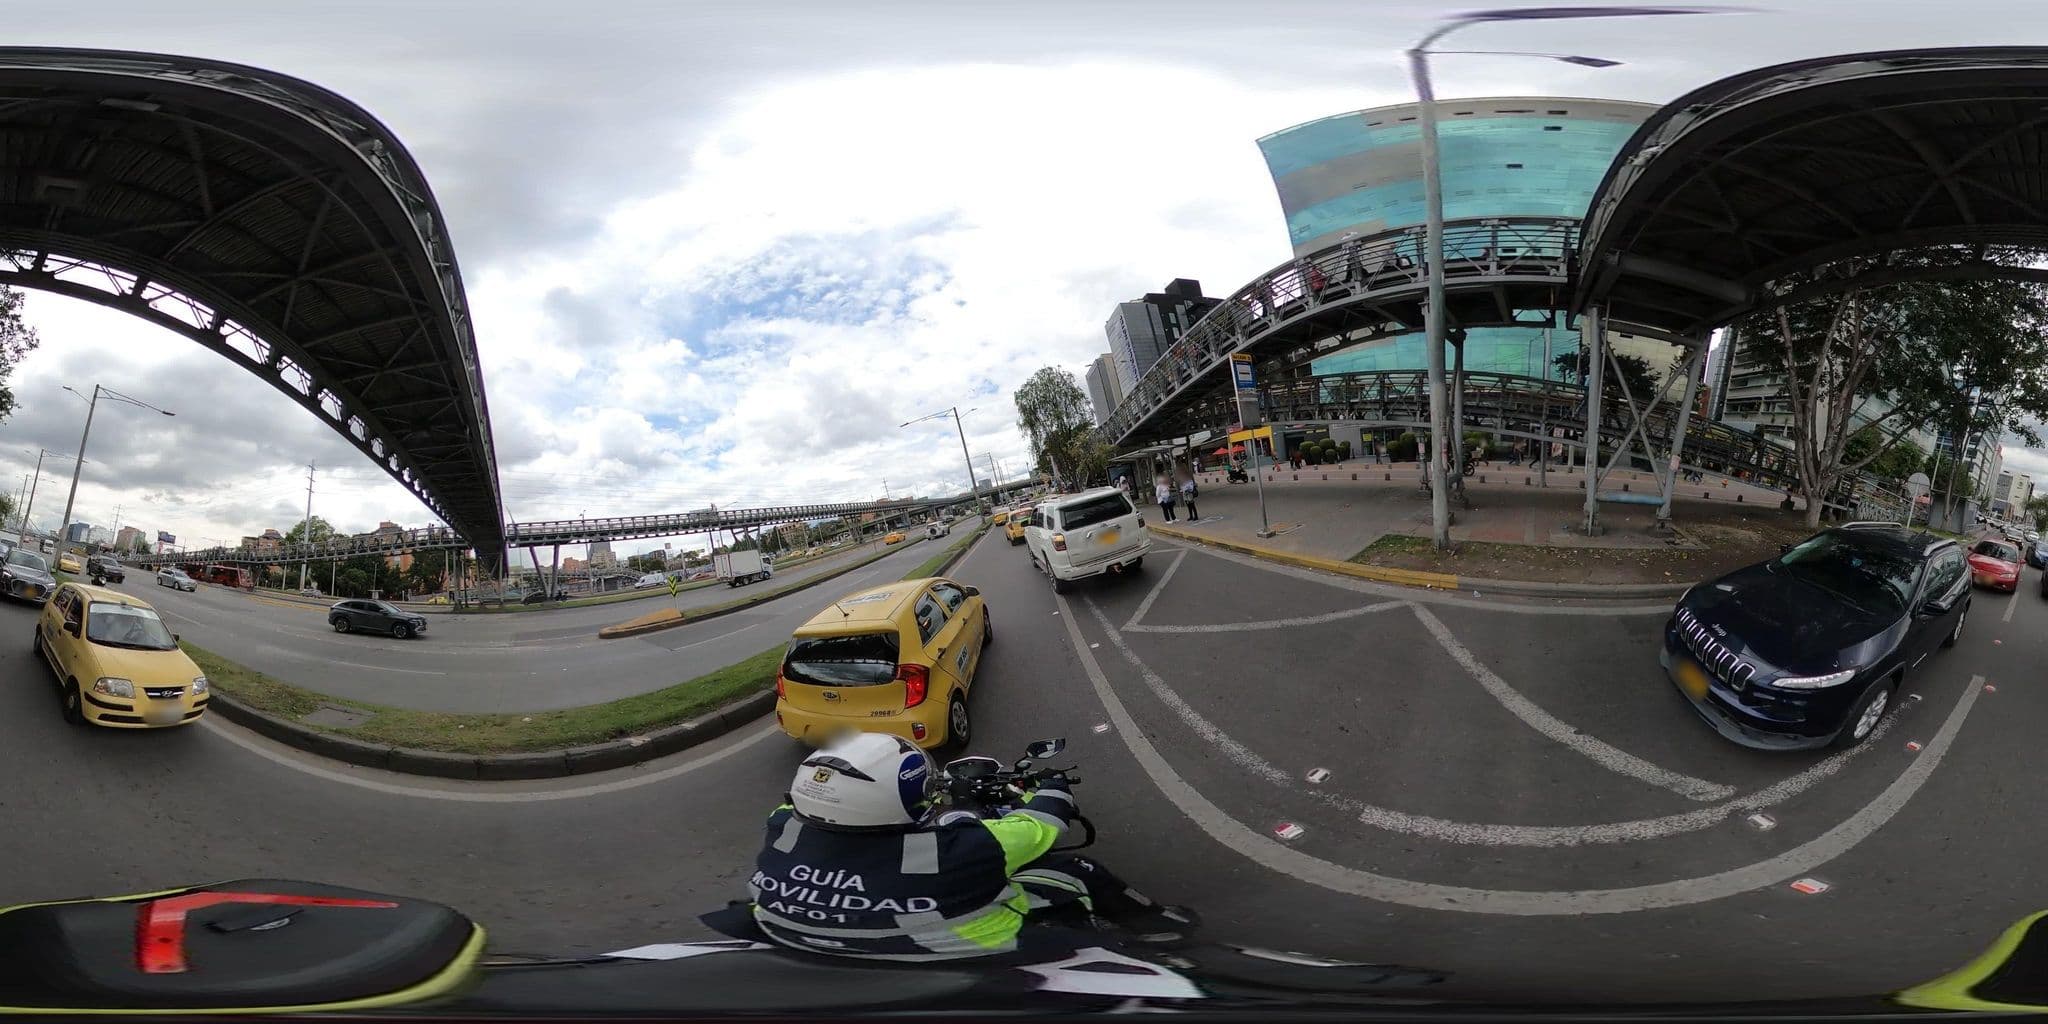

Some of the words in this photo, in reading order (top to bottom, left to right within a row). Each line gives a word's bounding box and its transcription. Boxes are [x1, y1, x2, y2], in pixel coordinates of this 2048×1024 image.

[1711, 623, 1727, 636] Jeep
[789, 864, 865, 892] GUÍA
[768, 901, 847, 923] AF01
